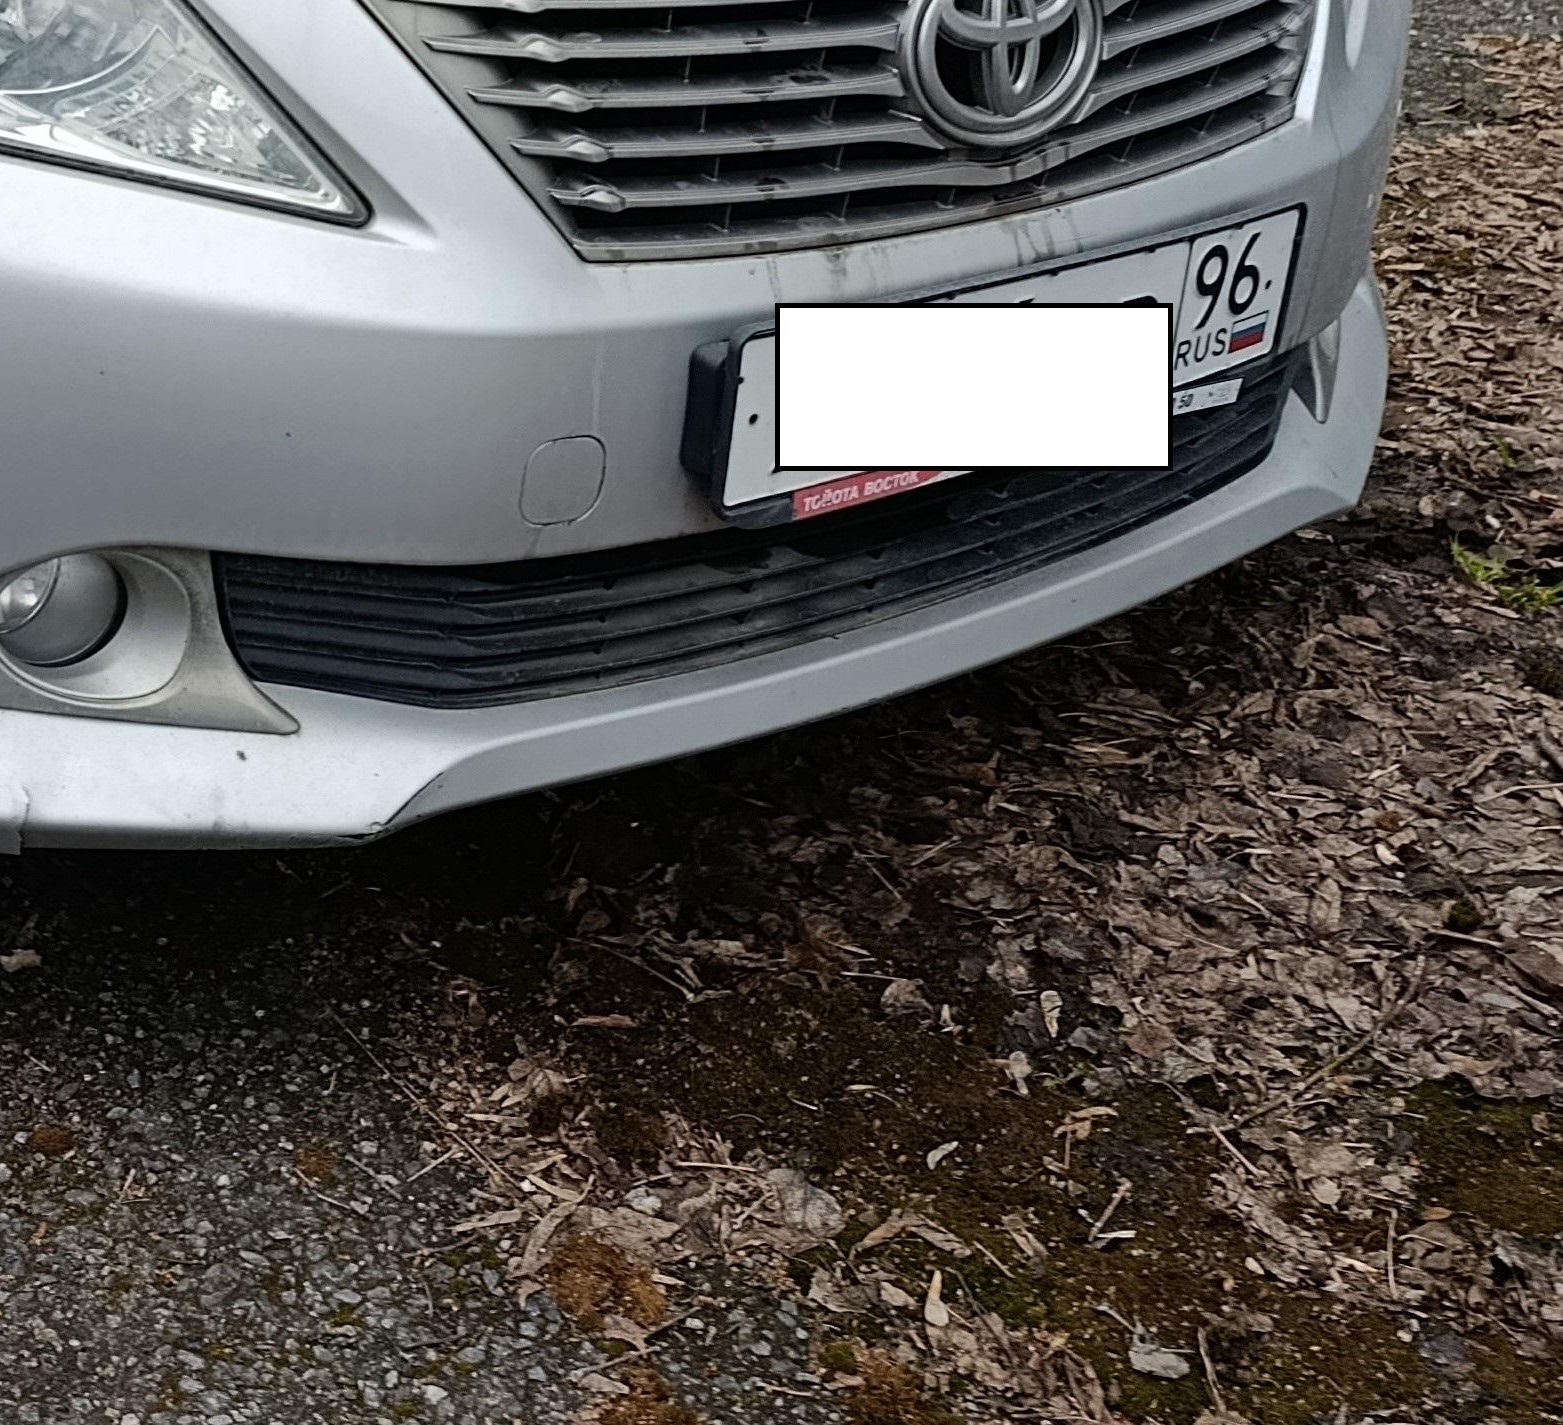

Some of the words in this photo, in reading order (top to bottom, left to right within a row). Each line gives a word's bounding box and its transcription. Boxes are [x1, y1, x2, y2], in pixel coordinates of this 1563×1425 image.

[1194, 231, 1262, 330] 96
[1173, 327, 1228, 371] RUS
[863, 470, 919, 496] ВОСТОК
